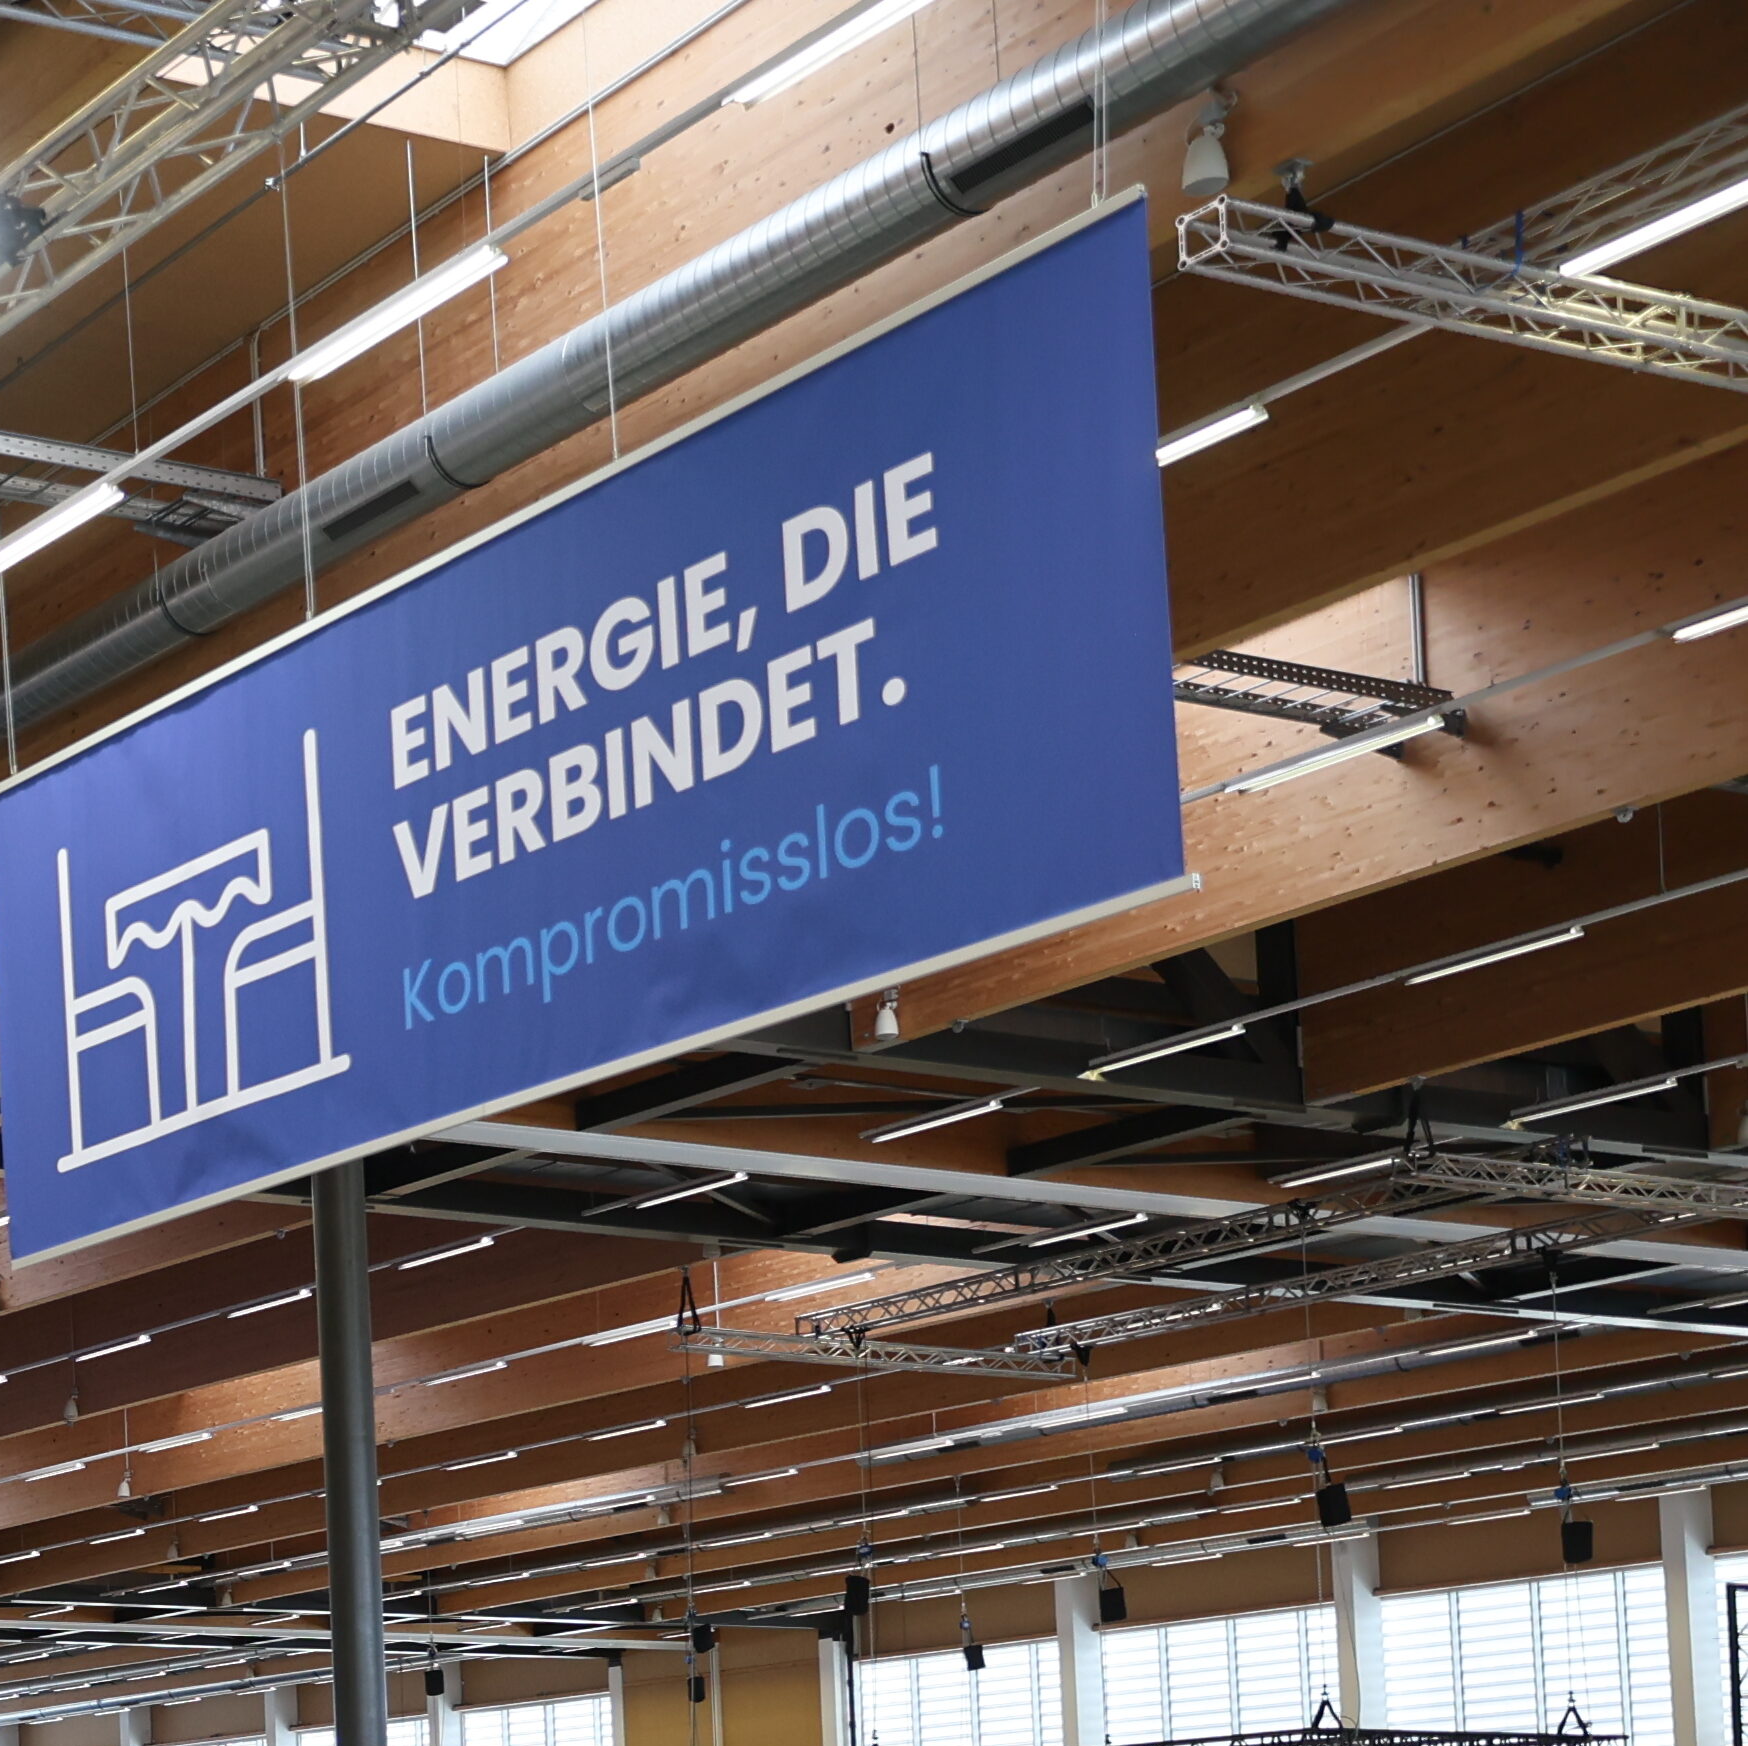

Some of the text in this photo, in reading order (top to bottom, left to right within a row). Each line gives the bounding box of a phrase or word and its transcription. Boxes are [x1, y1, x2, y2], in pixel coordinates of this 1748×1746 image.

[391, 450, 940, 790] ENERGIE, DIE
[392, 617, 908, 901] VERBINDET.
[403, 765, 946, 1031] Kompromisslos!
